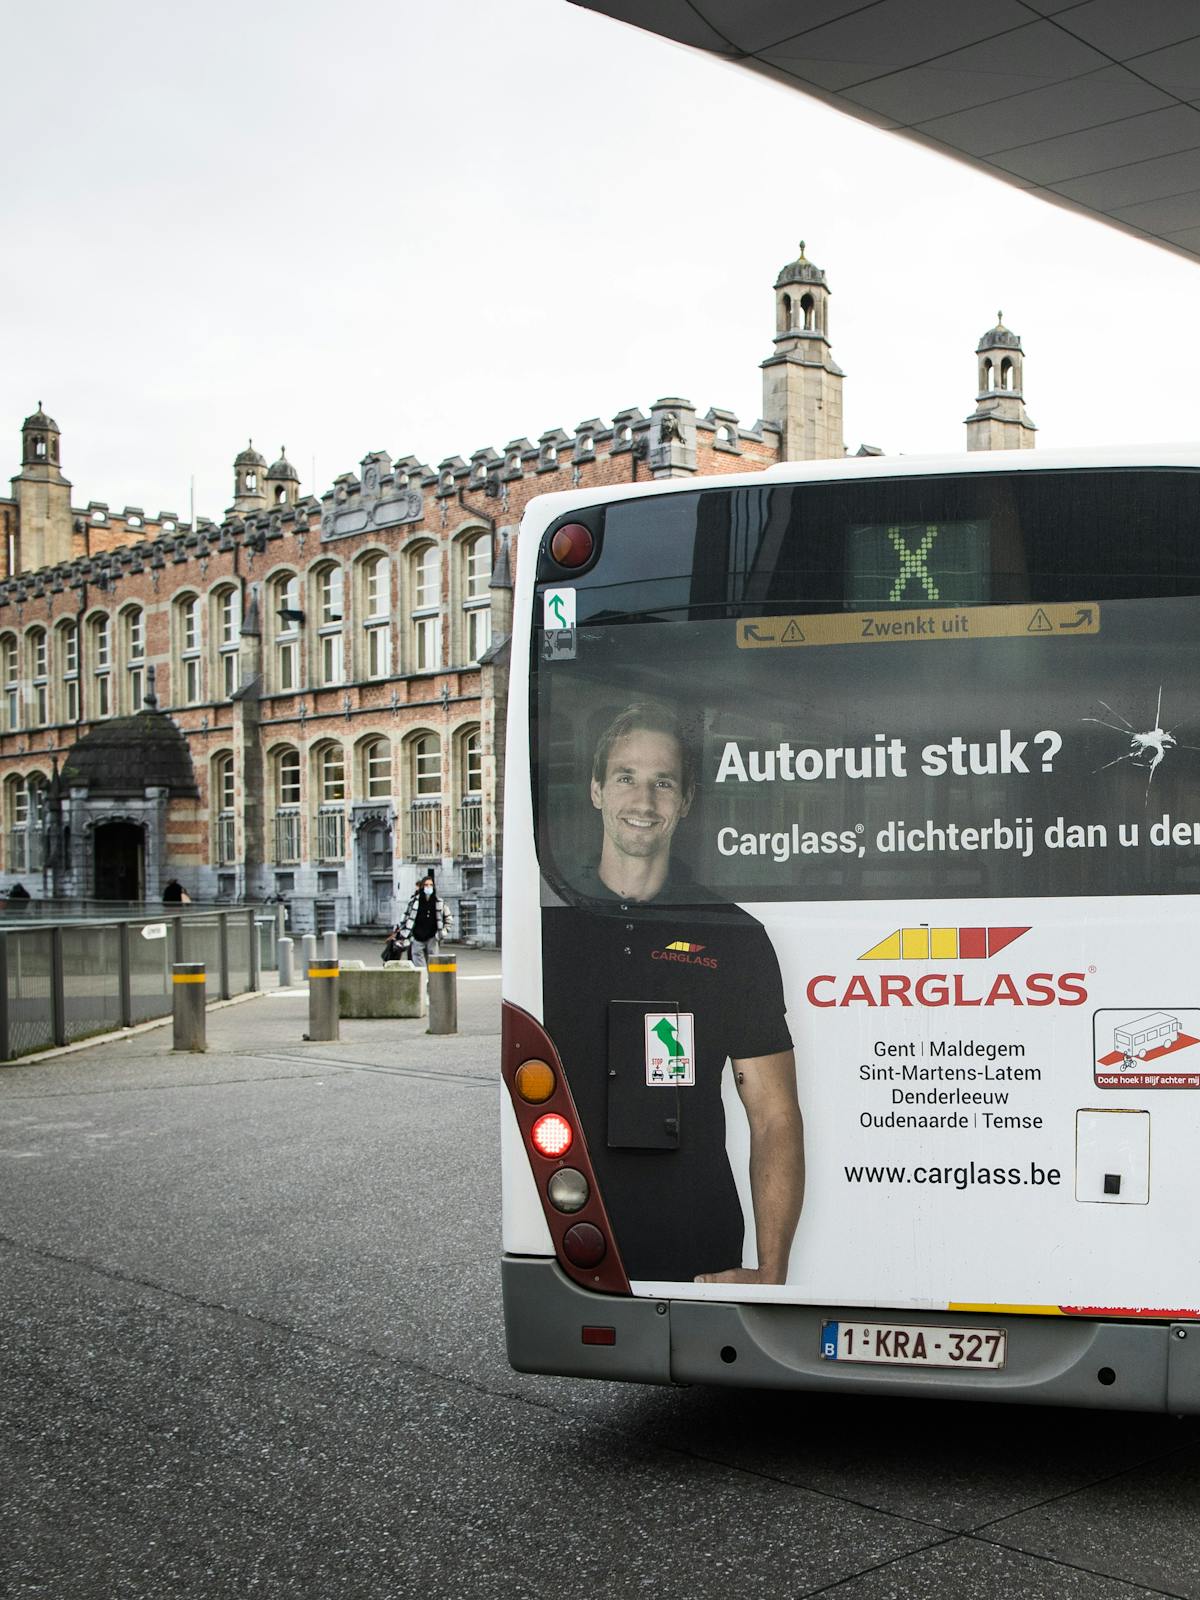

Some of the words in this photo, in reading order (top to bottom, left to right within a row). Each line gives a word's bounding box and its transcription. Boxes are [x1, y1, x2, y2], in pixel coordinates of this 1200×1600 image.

[888, 526, 939, 602] X
[861, 616, 936, 637] Zwenkt
[942, 614, 969, 633] uit
[716, 734, 906, 783] Autoruit
[922, 728, 1064, 776] stuk?
[877, 819, 1035, 857] dichterbij
[1045, 817, 1107, 850] dan
[1118, 826, 1139, 848] u
[651, 949, 718, 968] CARGLASS
[873, 1038, 916, 1058] Gent
[929, 1038, 1026, 1062] Maldegem
[859, 1062, 1042, 1083] Sint-Martens-Latem
[1098, 1076, 1119, 1084] Dode
[1120, 1076, 1140, 1084] hoek
[1145, 1076, 1160, 1086] Blijf
[1161, 1076, 1186, 1084] achter
[1188, 1076, 1200, 1086] mij
[892, 1086, 1010, 1107] Denderleeuw
[859, 1110, 969, 1131] Oudenaarde
[981, 1110, 1043, 1131] Temse
[844, 1161, 1062, 1190] www.carglass.be
[825, 1343, 835, 1356] B
